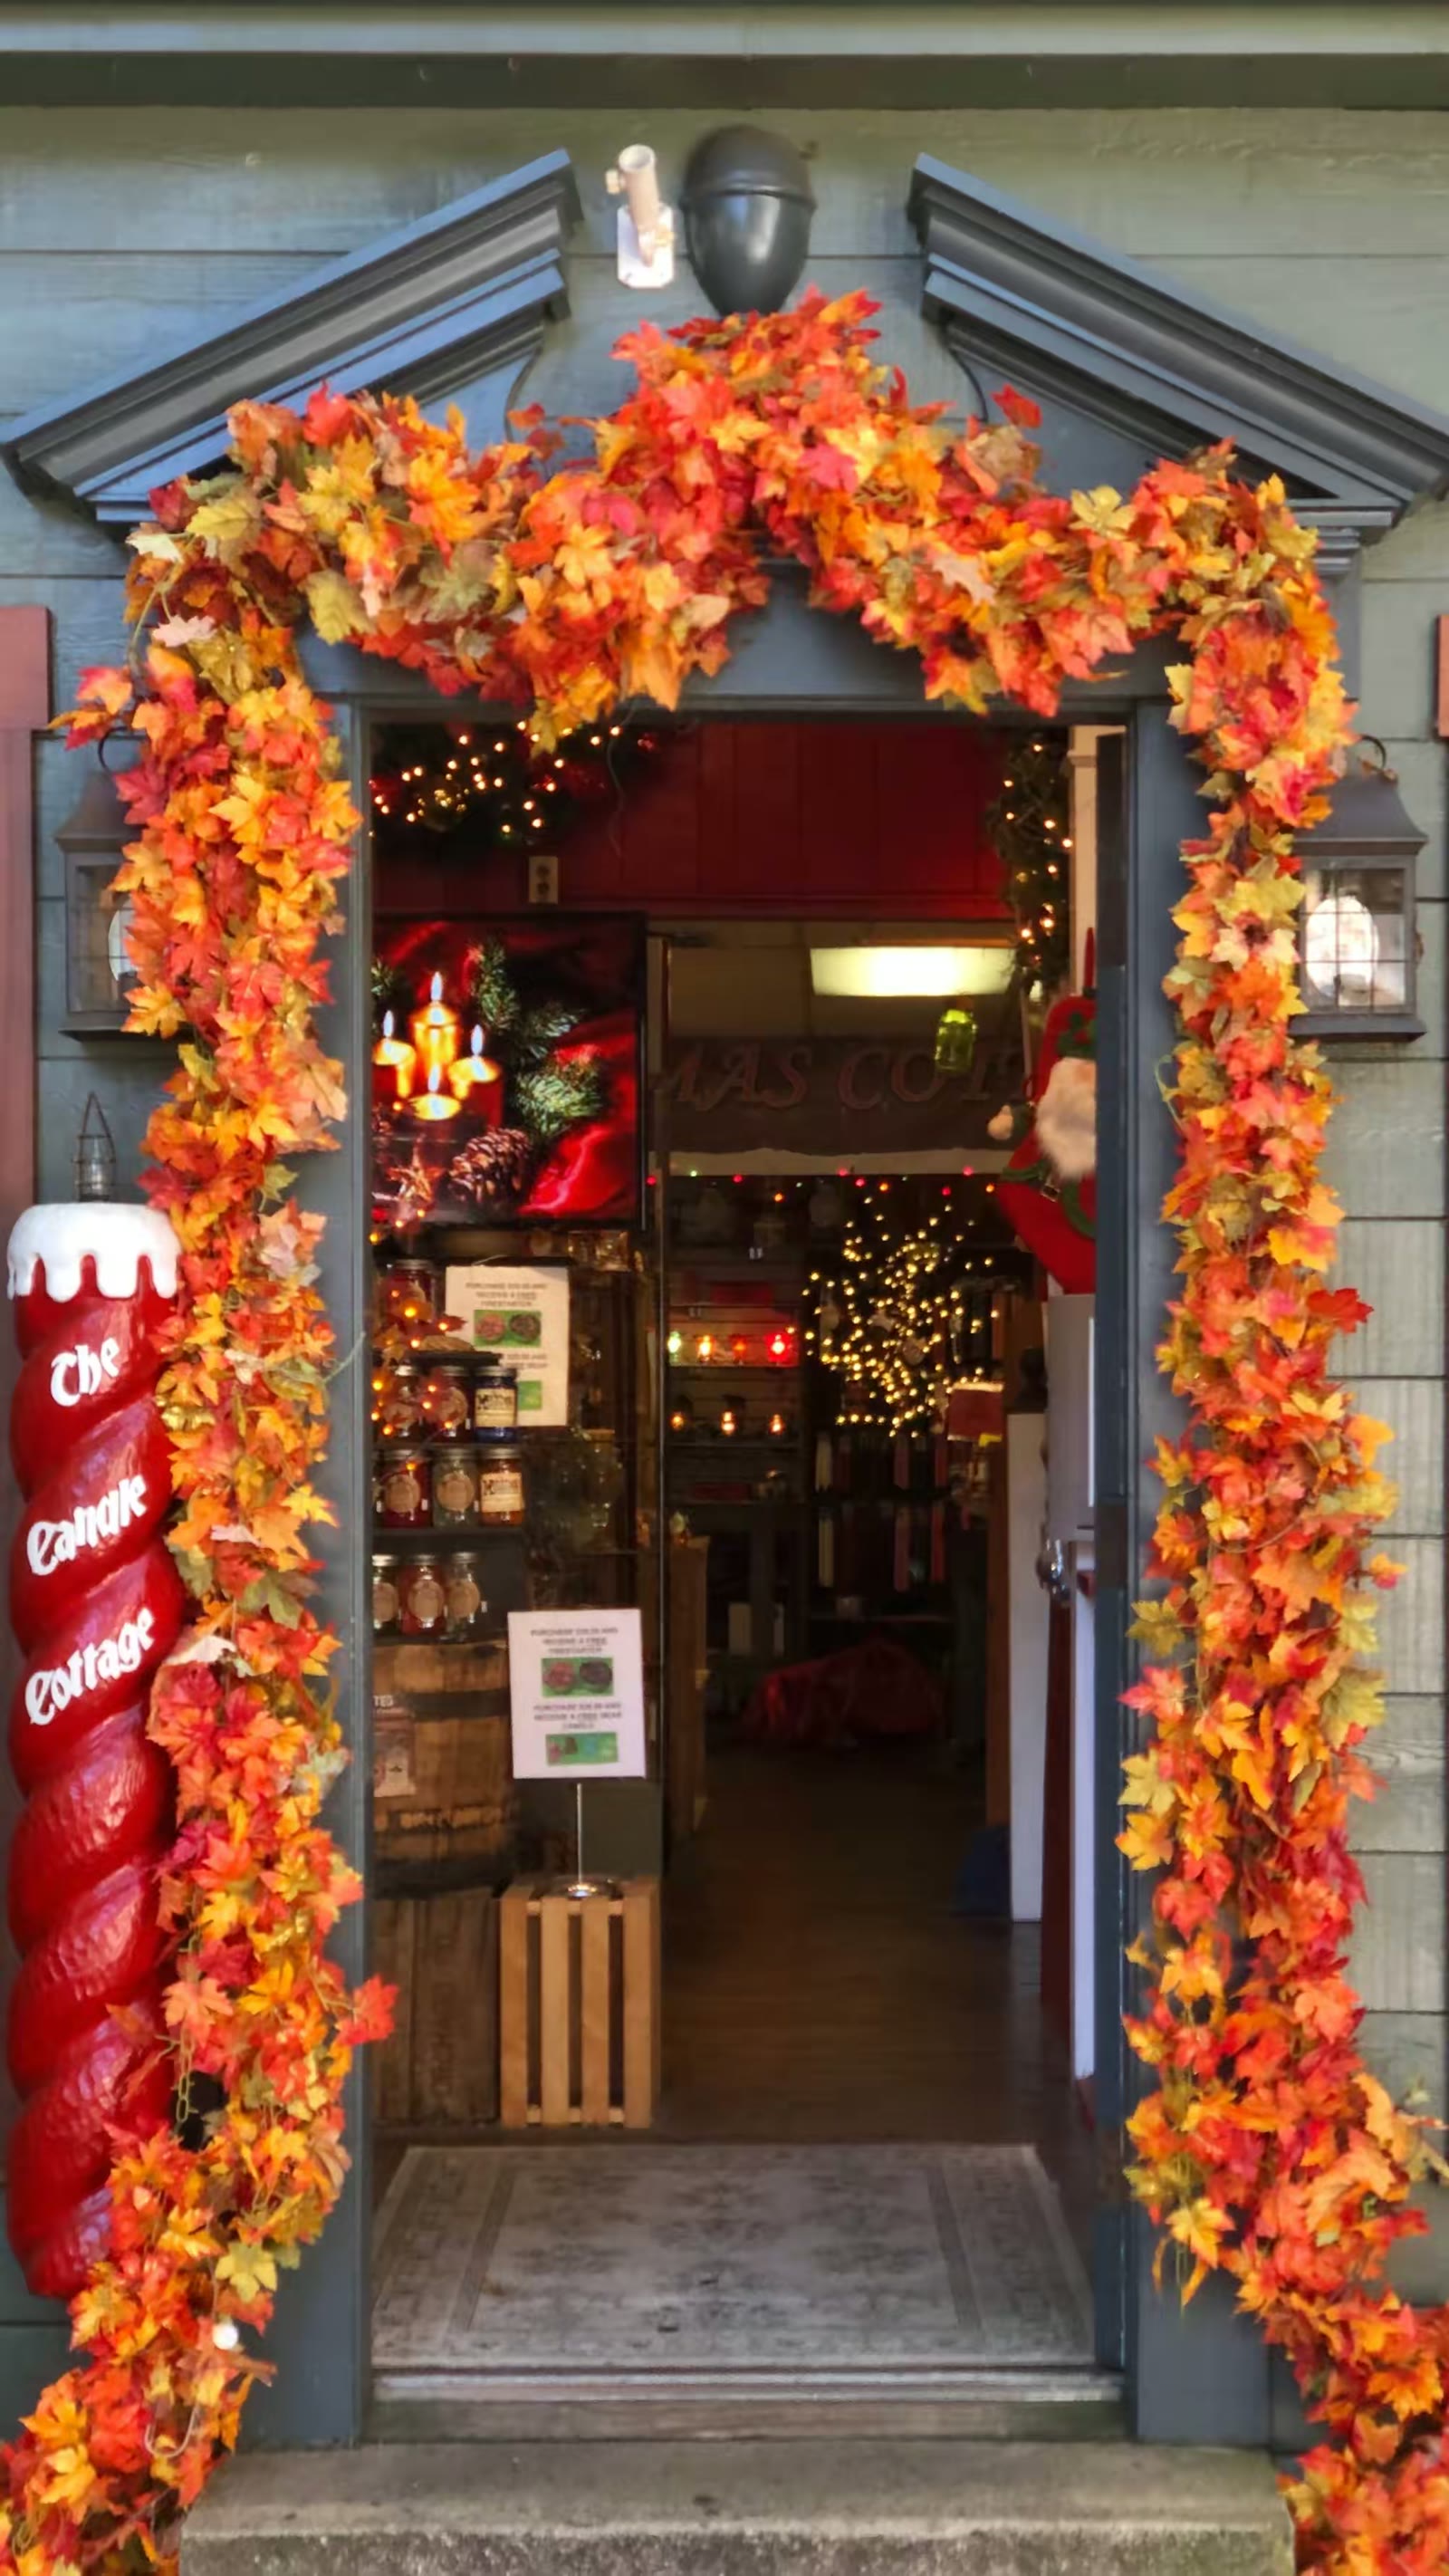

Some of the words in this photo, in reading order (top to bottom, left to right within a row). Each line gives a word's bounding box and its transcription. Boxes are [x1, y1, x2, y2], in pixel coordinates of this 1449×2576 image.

[51, 1336, 120, 1407] The
[27, 1475, 148, 1576] Candle
[24, 1606, 154, 1725] Cottage
